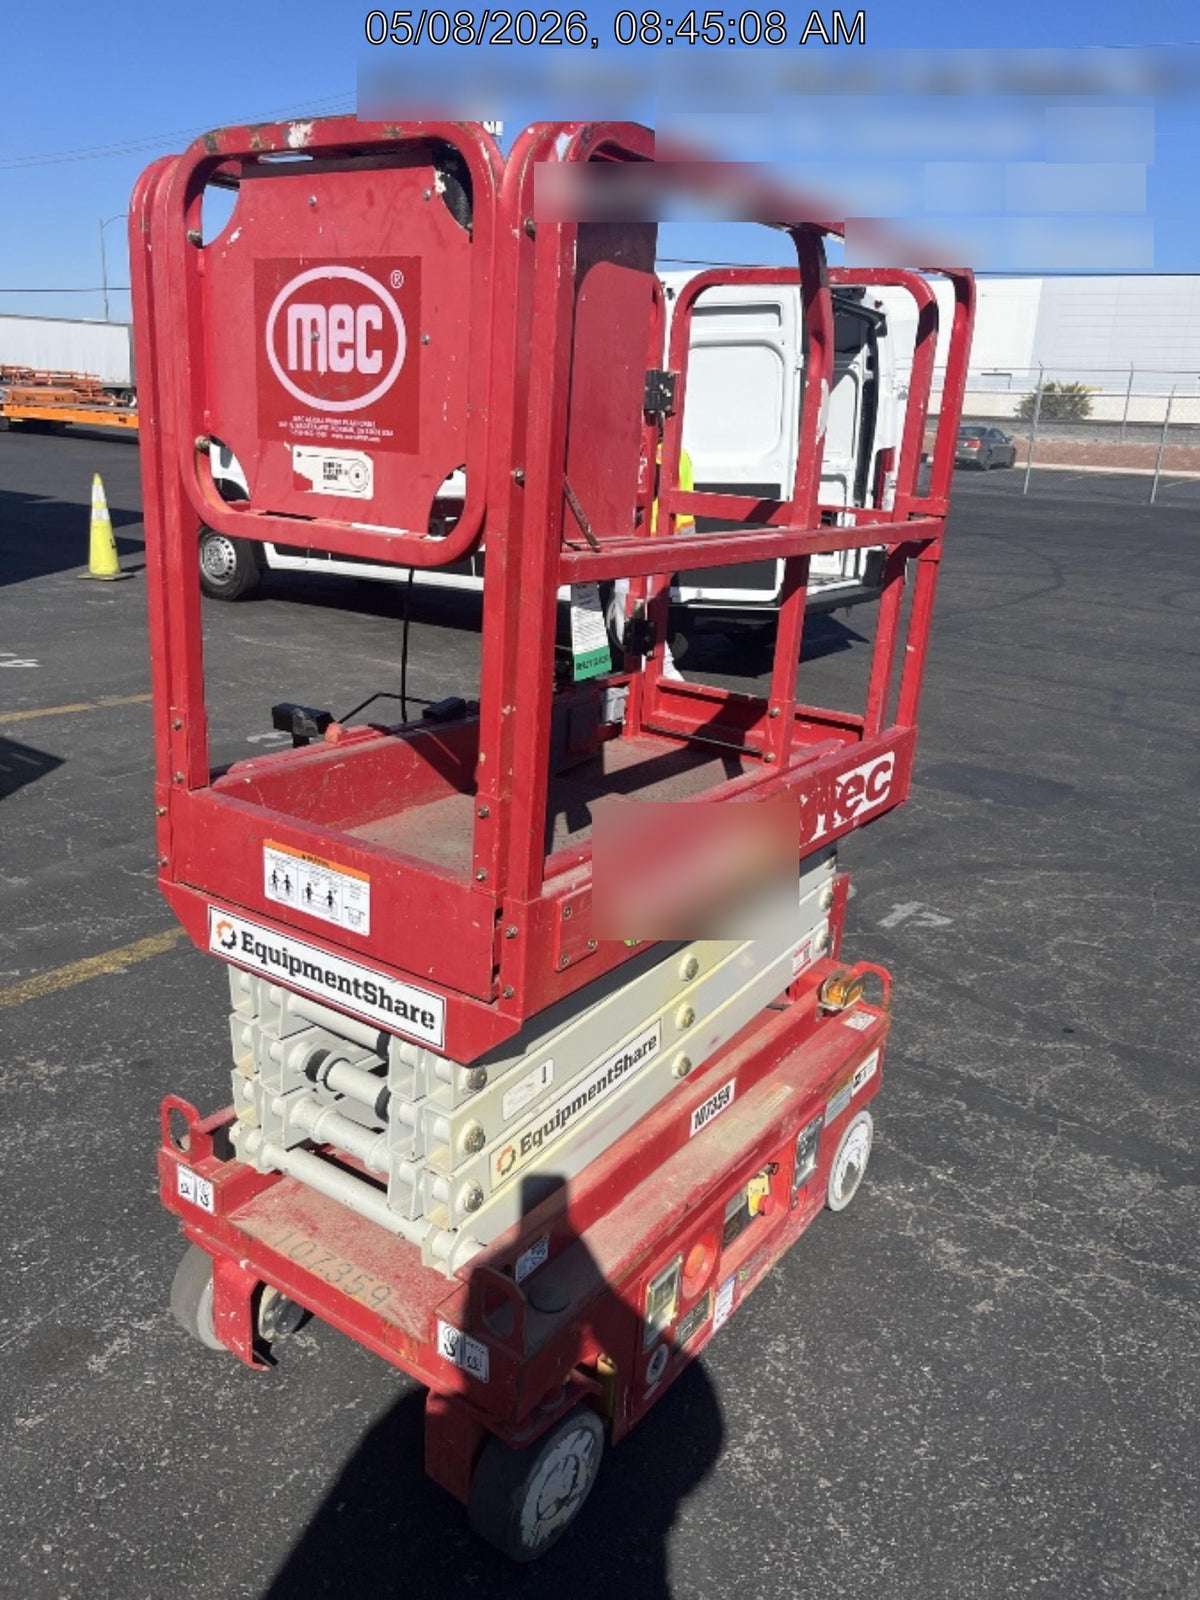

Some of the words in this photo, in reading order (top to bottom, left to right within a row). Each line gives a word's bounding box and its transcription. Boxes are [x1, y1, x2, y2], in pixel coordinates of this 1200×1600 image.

[240, 930, 435, 1031] EquipmentShare
[519, 1034, 658, 1158] EquipmentShare
[273, 1230, 392, 1309] 107359
